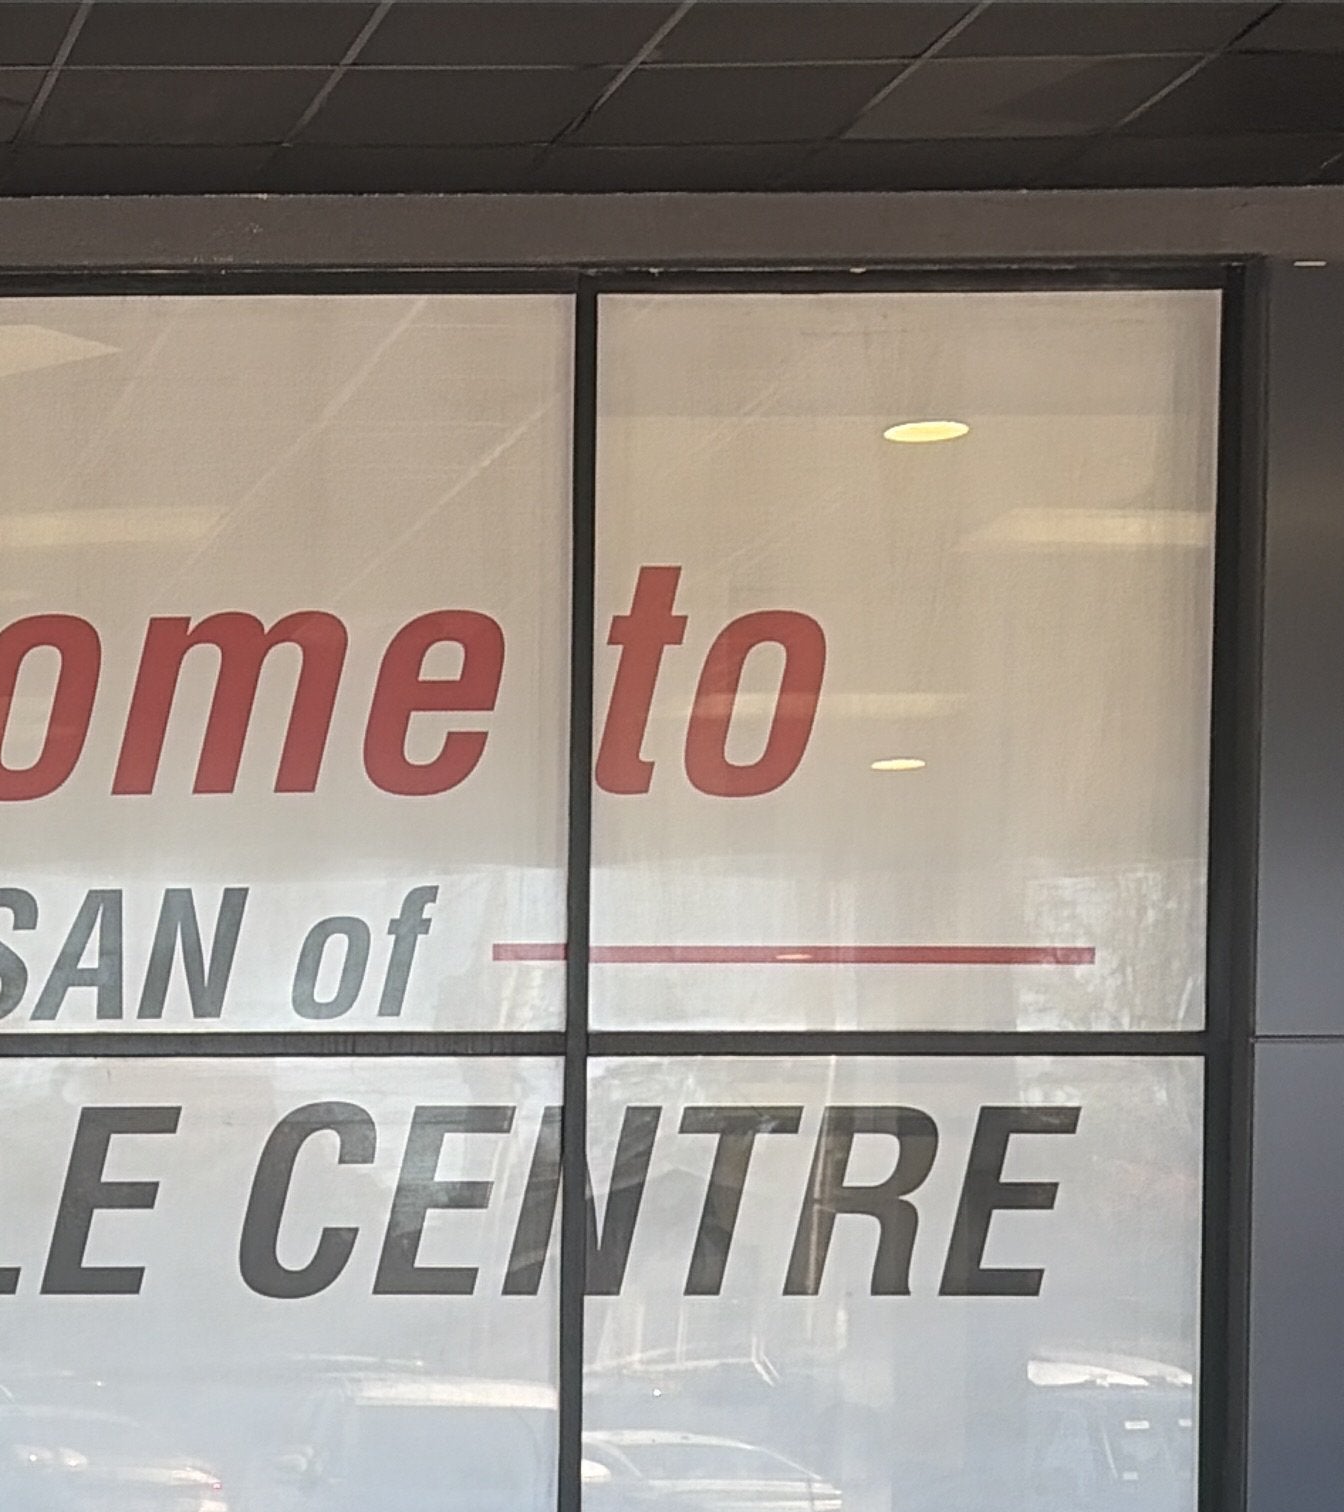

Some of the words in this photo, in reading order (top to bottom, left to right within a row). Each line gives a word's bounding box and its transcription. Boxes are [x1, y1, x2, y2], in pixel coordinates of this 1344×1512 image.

[594, 565, 827, 798] to
[290, 884, 439, 1020] of
[238, 1100, 1082, 1300] CENTRE
